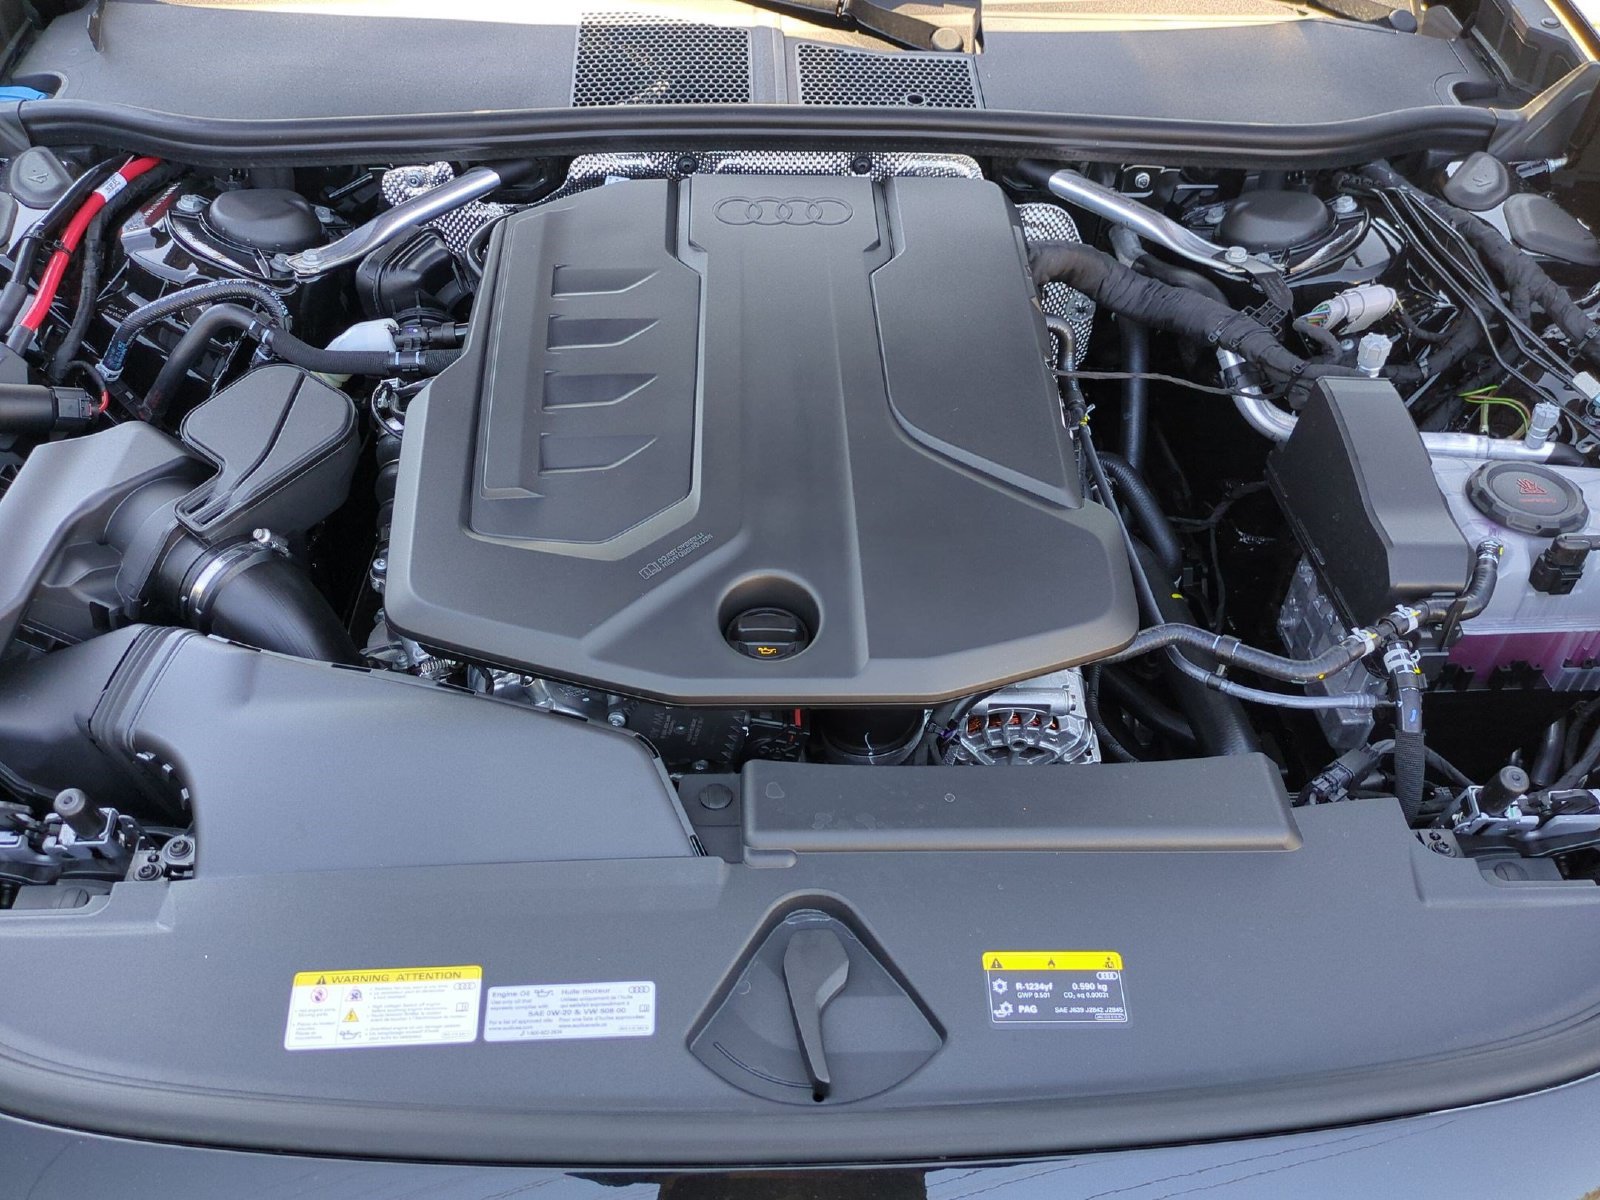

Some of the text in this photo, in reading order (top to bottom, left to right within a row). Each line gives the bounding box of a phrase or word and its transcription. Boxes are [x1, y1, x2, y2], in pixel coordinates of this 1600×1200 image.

[331, 972, 462, 984] WARNING ATTENTION
[1016, 982, 1108, 992] R-1234yf 0.590 kg
[1018, 1005, 1038, 1014] PAG
